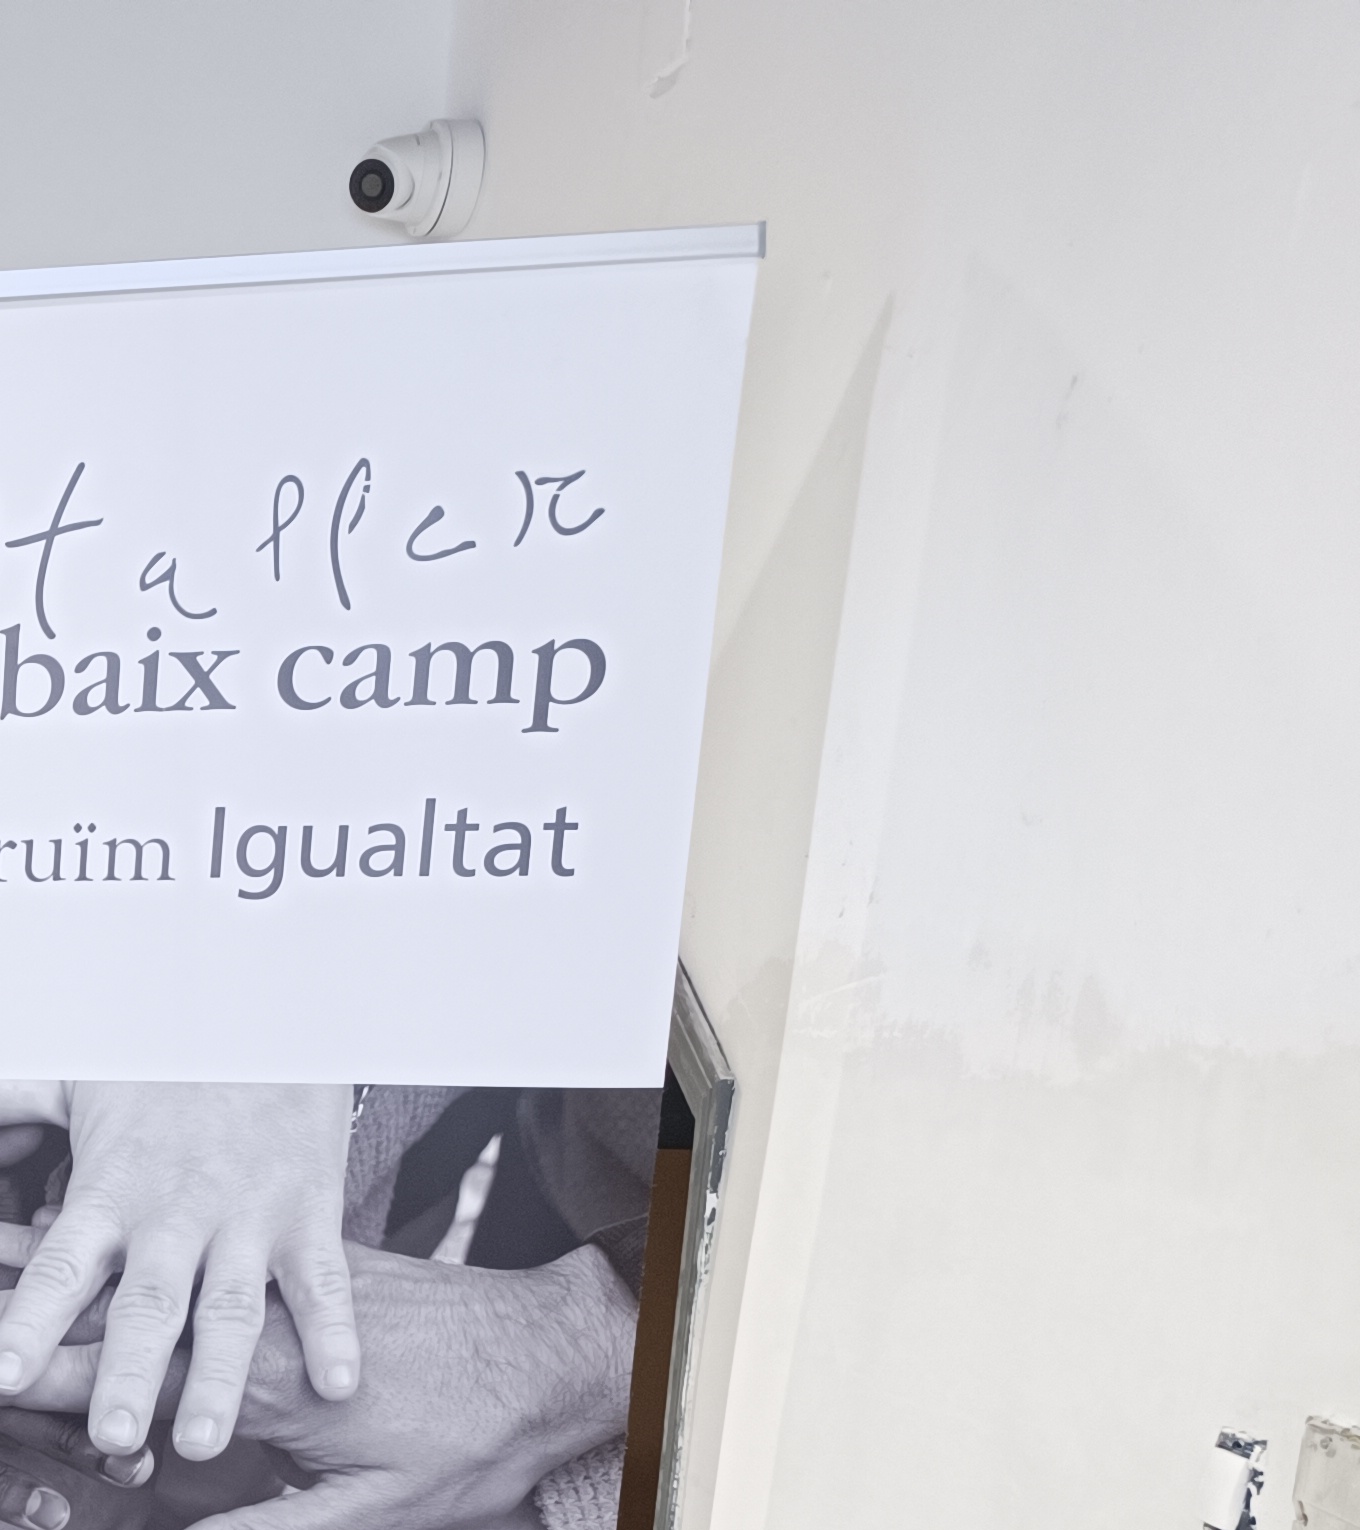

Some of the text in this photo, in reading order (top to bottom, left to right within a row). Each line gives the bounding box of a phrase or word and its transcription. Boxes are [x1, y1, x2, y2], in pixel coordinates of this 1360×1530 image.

[5, 458, 606, 638] taller
[0, 625, 607, 733] baix camp
[209, 797, 579, 900] Igualtat
